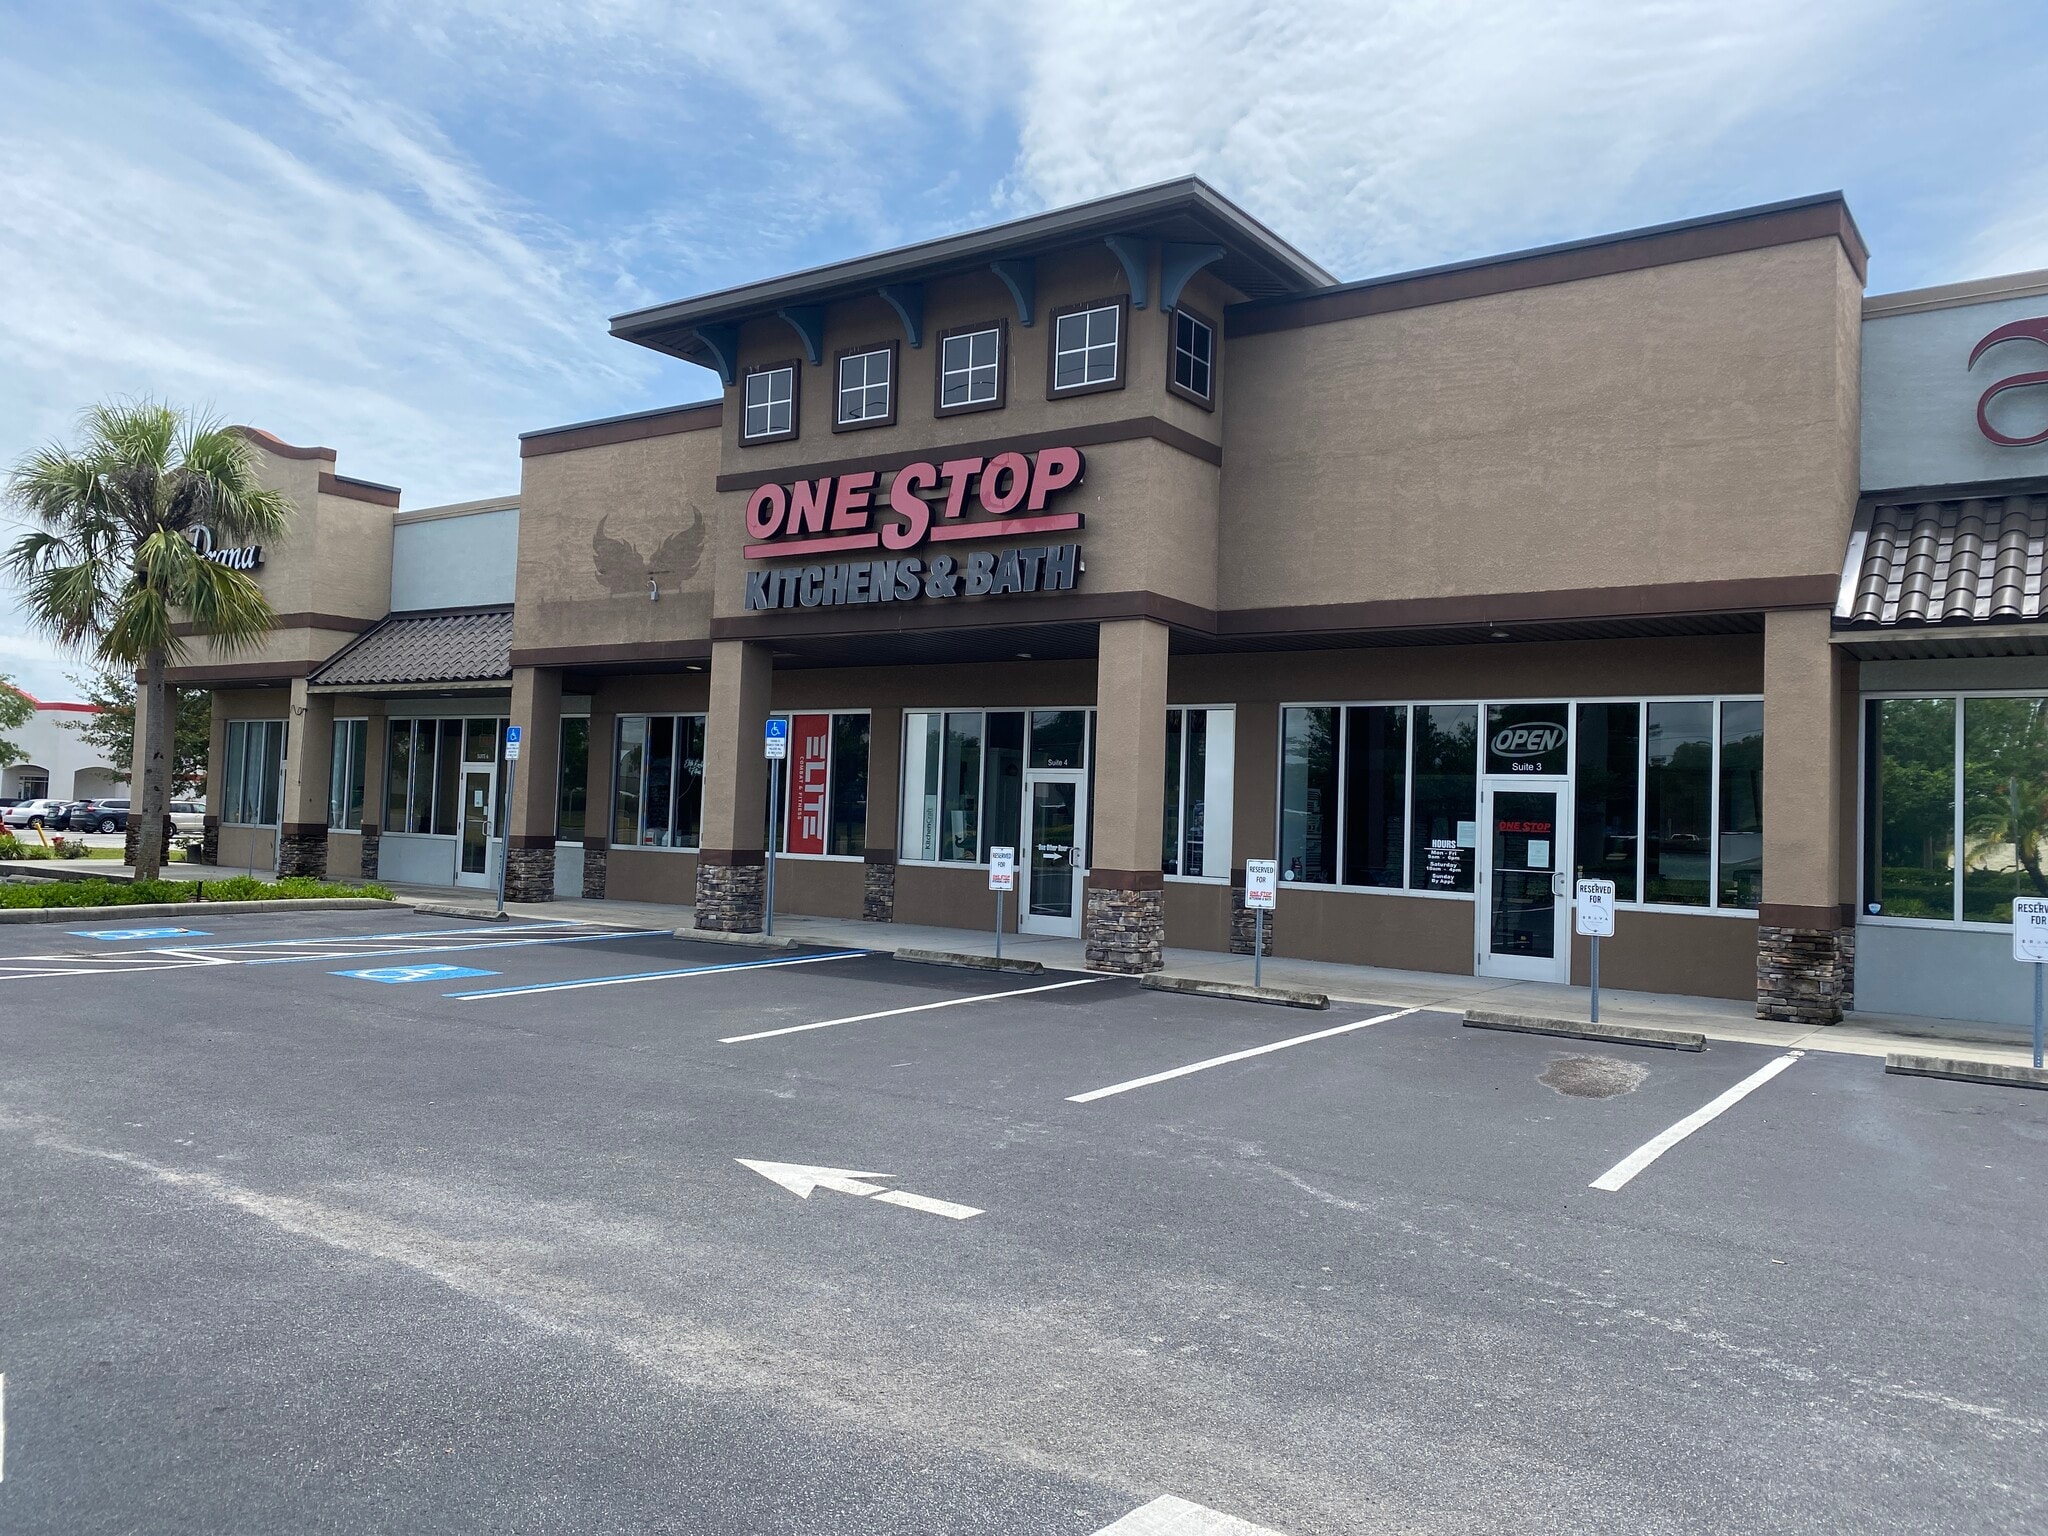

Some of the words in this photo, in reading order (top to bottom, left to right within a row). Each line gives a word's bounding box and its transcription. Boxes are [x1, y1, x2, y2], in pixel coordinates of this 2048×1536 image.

[745, 471, 880, 541] ONE
[881, 446, 1085, 551] STOP
[745, 557, 924, 610] KITCHENS
[965, 543, 1080, 596] BATH
[1495, 729, 1559, 750] OPEN
[1512, 762, 1534, 771] Suite
[1536, 762, 1542, 771] 3
[802, 734, 826, 840] ELITE
[1499, 821, 1520, 830] ONE
[1522, 821, 1552, 832] STOP
[1431, 839, 1457, 848] HOURS
[992, 852, 1012, 860] RESERVED
[1249, 866, 1273, 874] RESERVED
[1579, 885, 1612, 895] RESERVED
[1589, 895, 1602, 904] FOR
[2031, 916, 2047, 925] FOR
